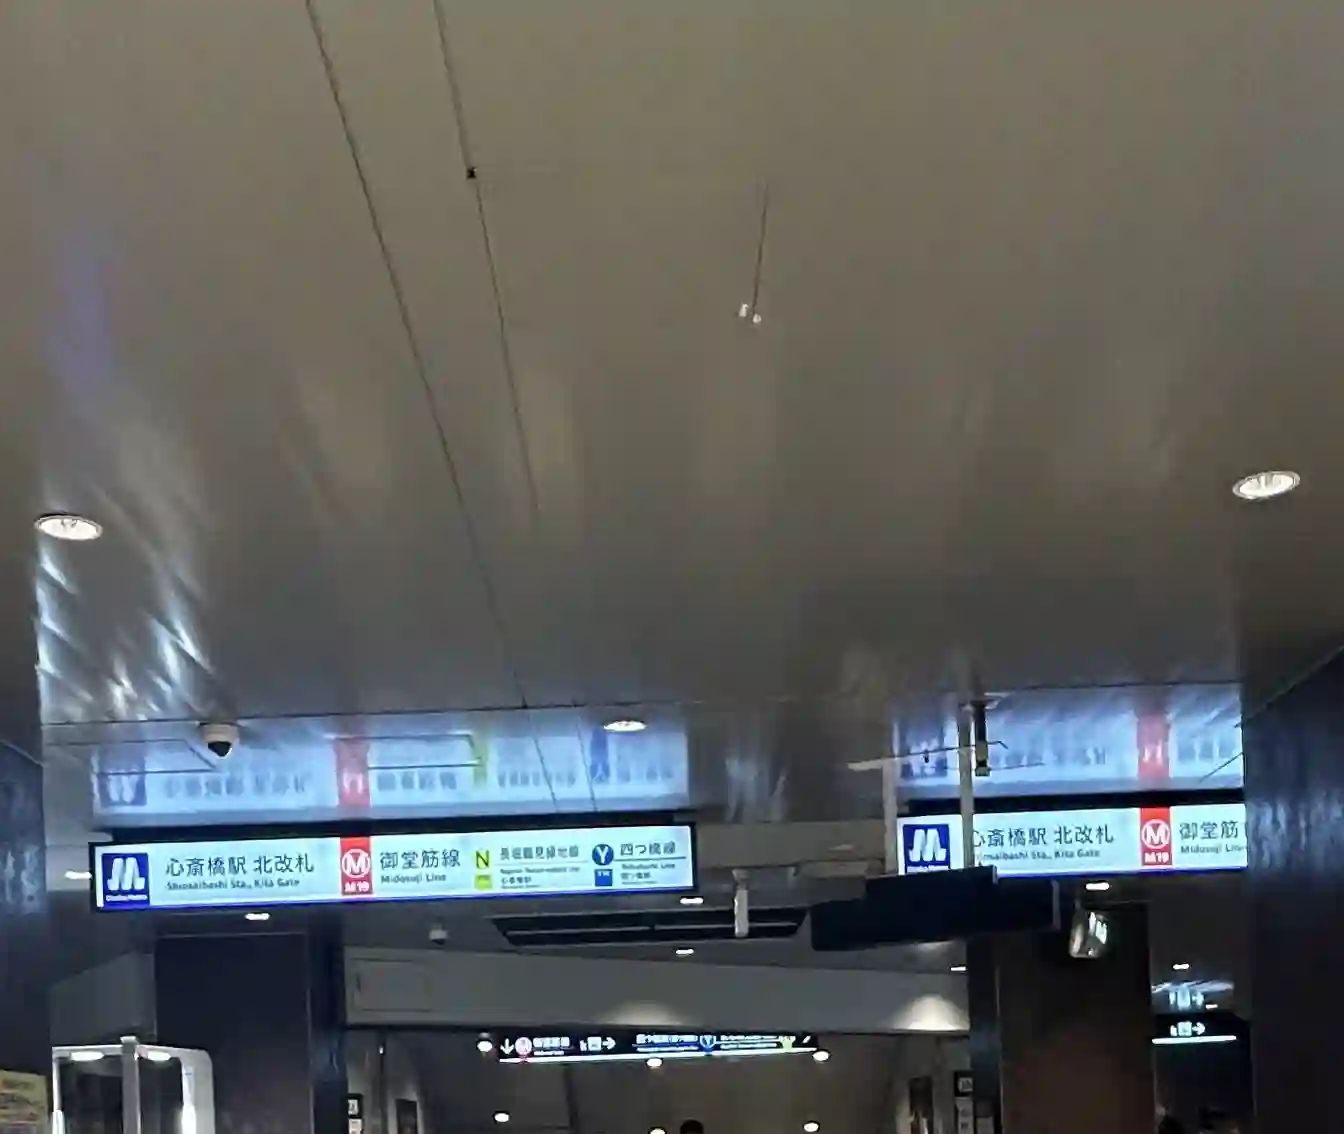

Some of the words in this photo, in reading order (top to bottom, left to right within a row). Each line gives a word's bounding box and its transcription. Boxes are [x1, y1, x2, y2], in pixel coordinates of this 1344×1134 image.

[1054, 823, 1115, 845] 北改札
[1180, 820, 1248, 840] 御堂筋
[1077, 848, 1101, 858] Gate
[1180, 843, 1221, 855] Midosuji
[380, 849, 461, 870] 御堂筋線
[476, 849, 490, 869] N
[1144, 851, 1169, 863] M19
[166, 855, 248, 877] 心斎橋駅
[253, 853, 315, 875] 北改札
[166, 879, 227, 891] Shinsaibashi
[254, 878, 275, 889] Kita
[277, 878, 300, 888] Gate
[381, 873, 423, 884] Midosuji
[426, 872, 446, 882] Line
[344, 881, 370, 892] M19
